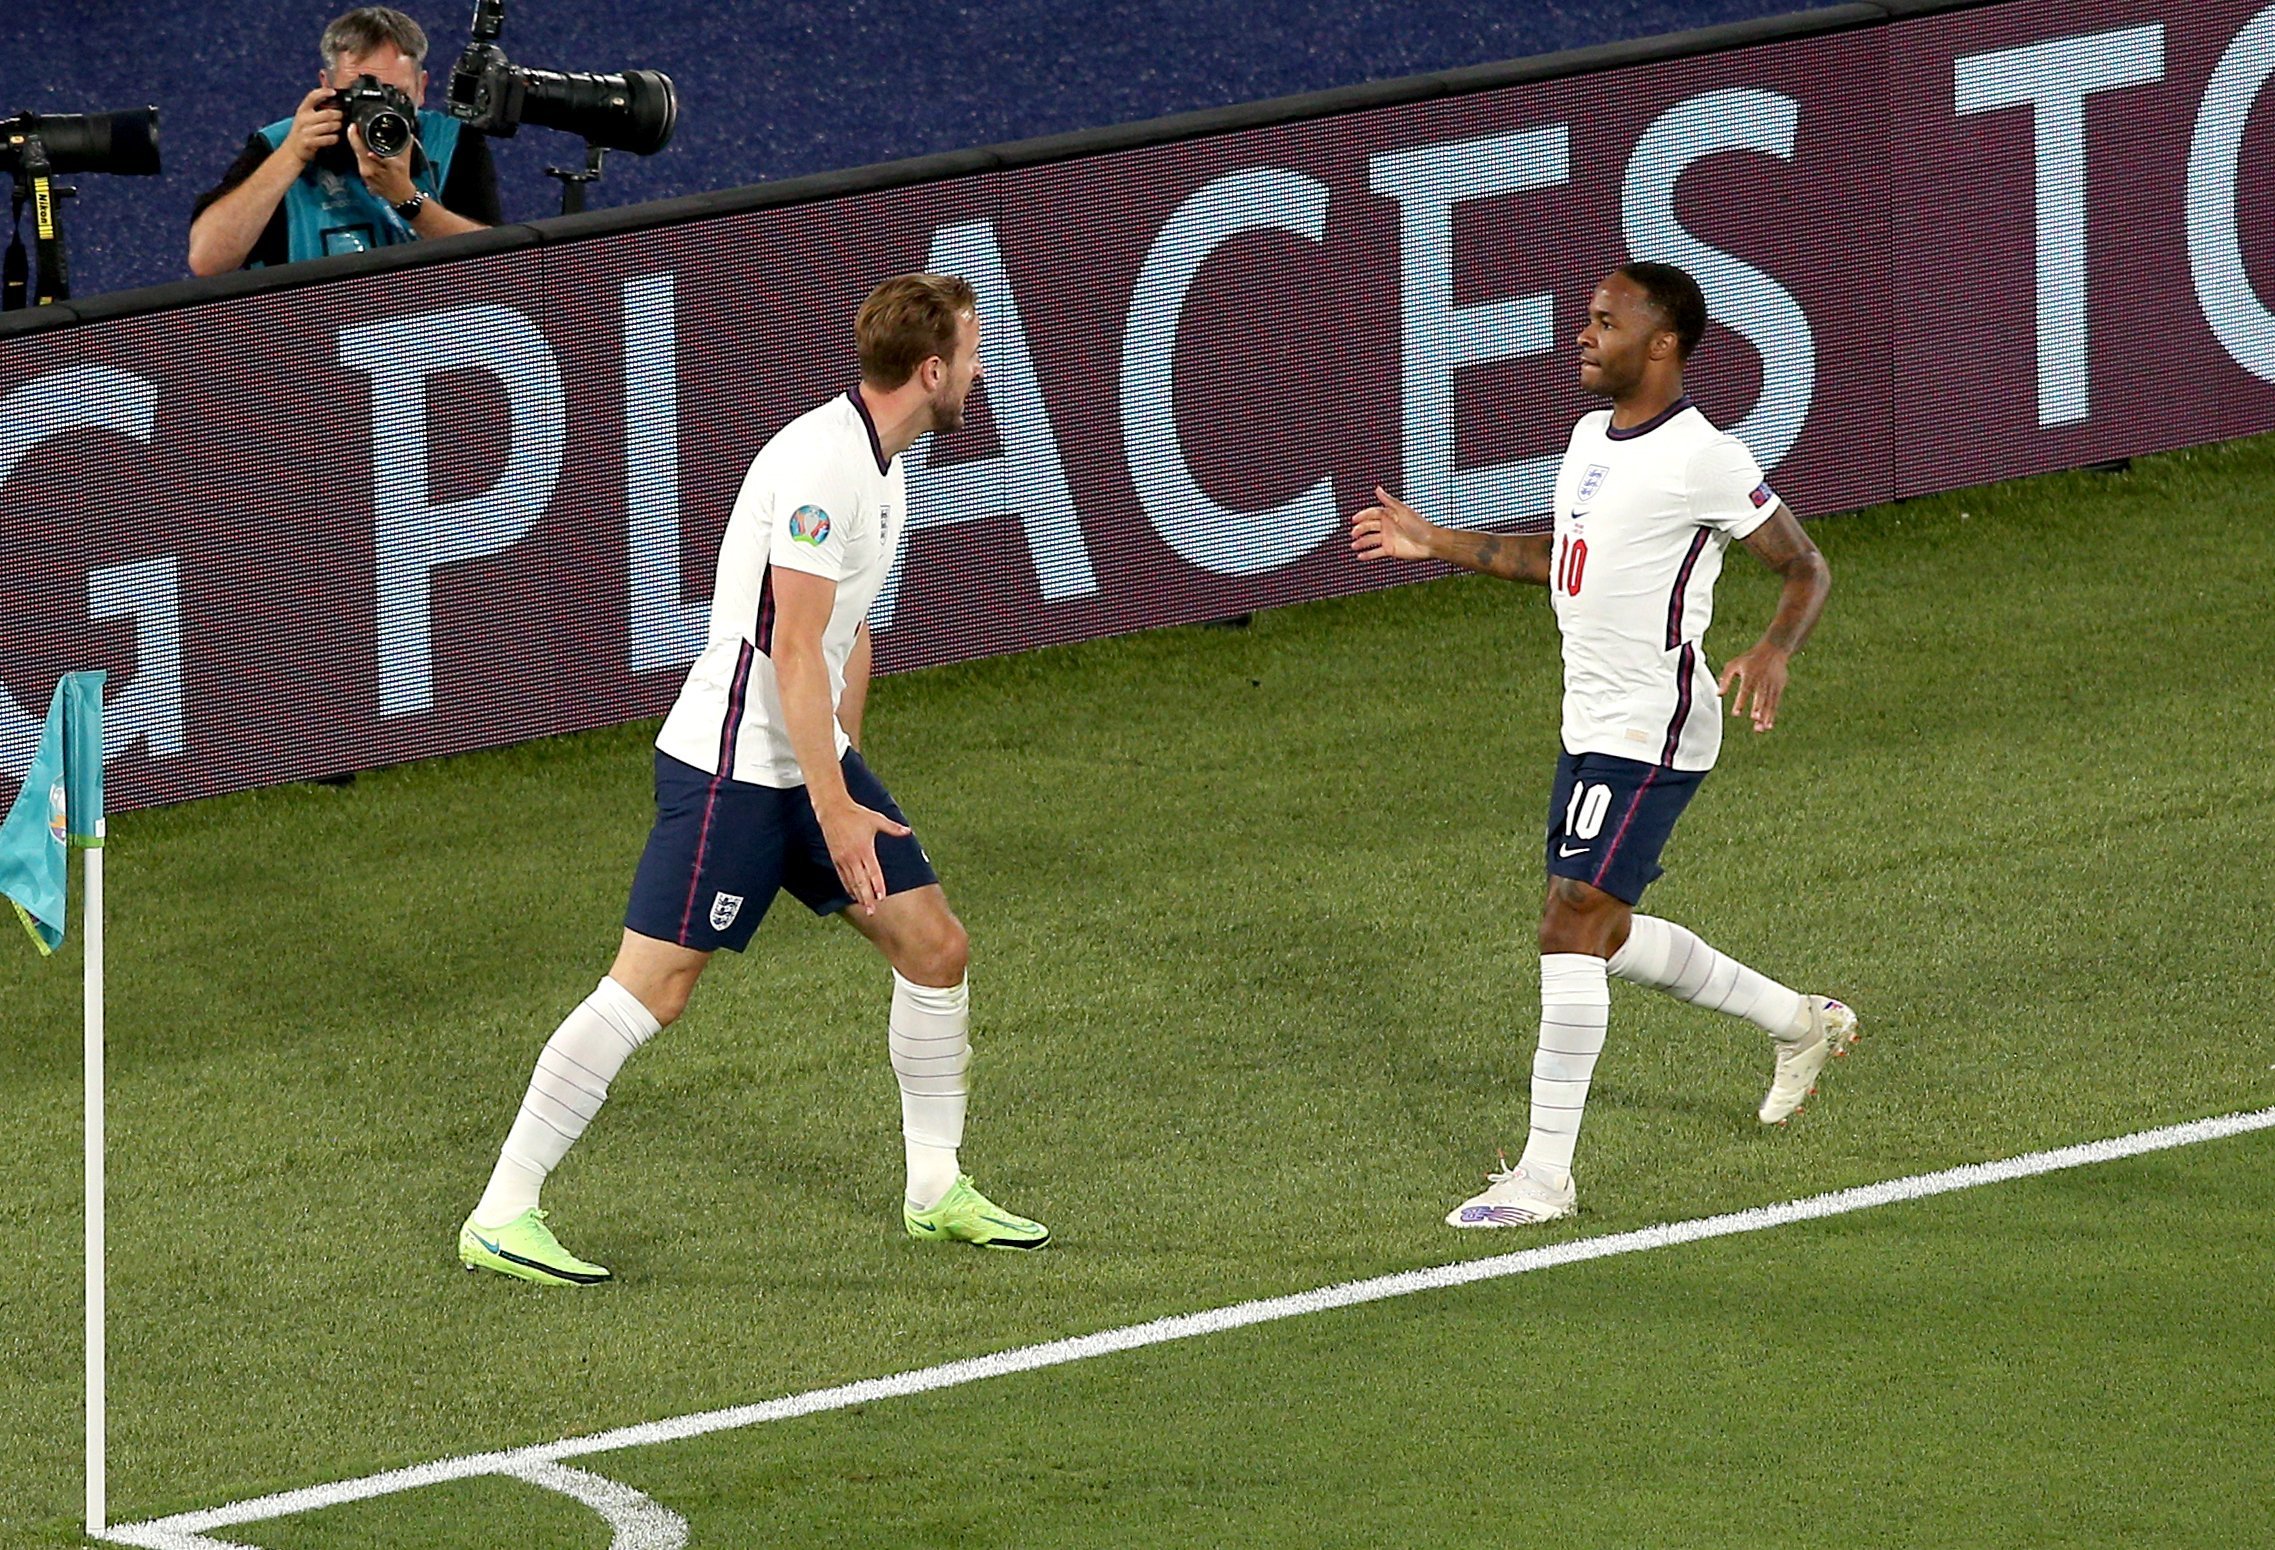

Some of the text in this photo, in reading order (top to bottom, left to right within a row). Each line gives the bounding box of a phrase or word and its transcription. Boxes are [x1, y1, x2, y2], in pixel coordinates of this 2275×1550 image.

[38, 194, 48, 224] Nikon
[338, 87, 1817, 717] PLACES
[1557, 533, 1588, 597] 10
[1565, 780, 1613, 840] 10
